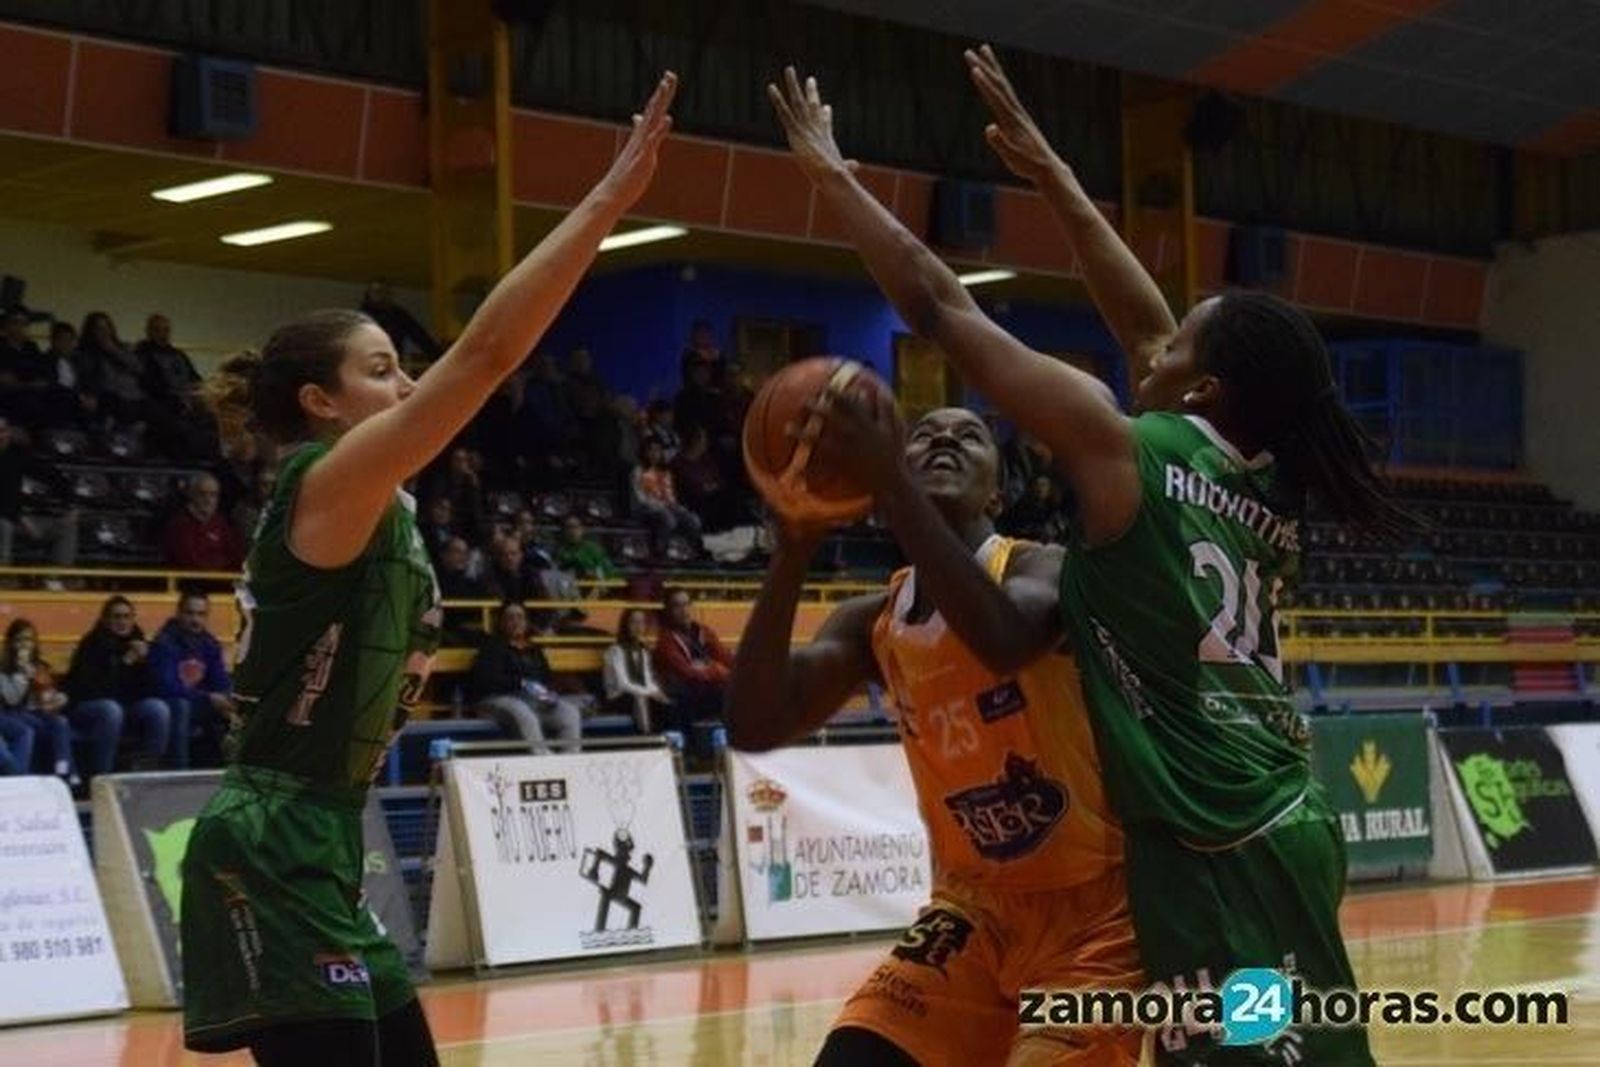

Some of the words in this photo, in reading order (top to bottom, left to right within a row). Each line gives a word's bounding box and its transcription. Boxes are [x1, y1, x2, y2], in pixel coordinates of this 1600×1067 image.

[524, 782, 562, 800] IES
[1365, 808, 1429, 840] RURAL
[795, 832, 923, 864] AYUNTAMIENTO
[795, 871, 820, 899] DE
[832, 866, 923, 897] ZAMORA
